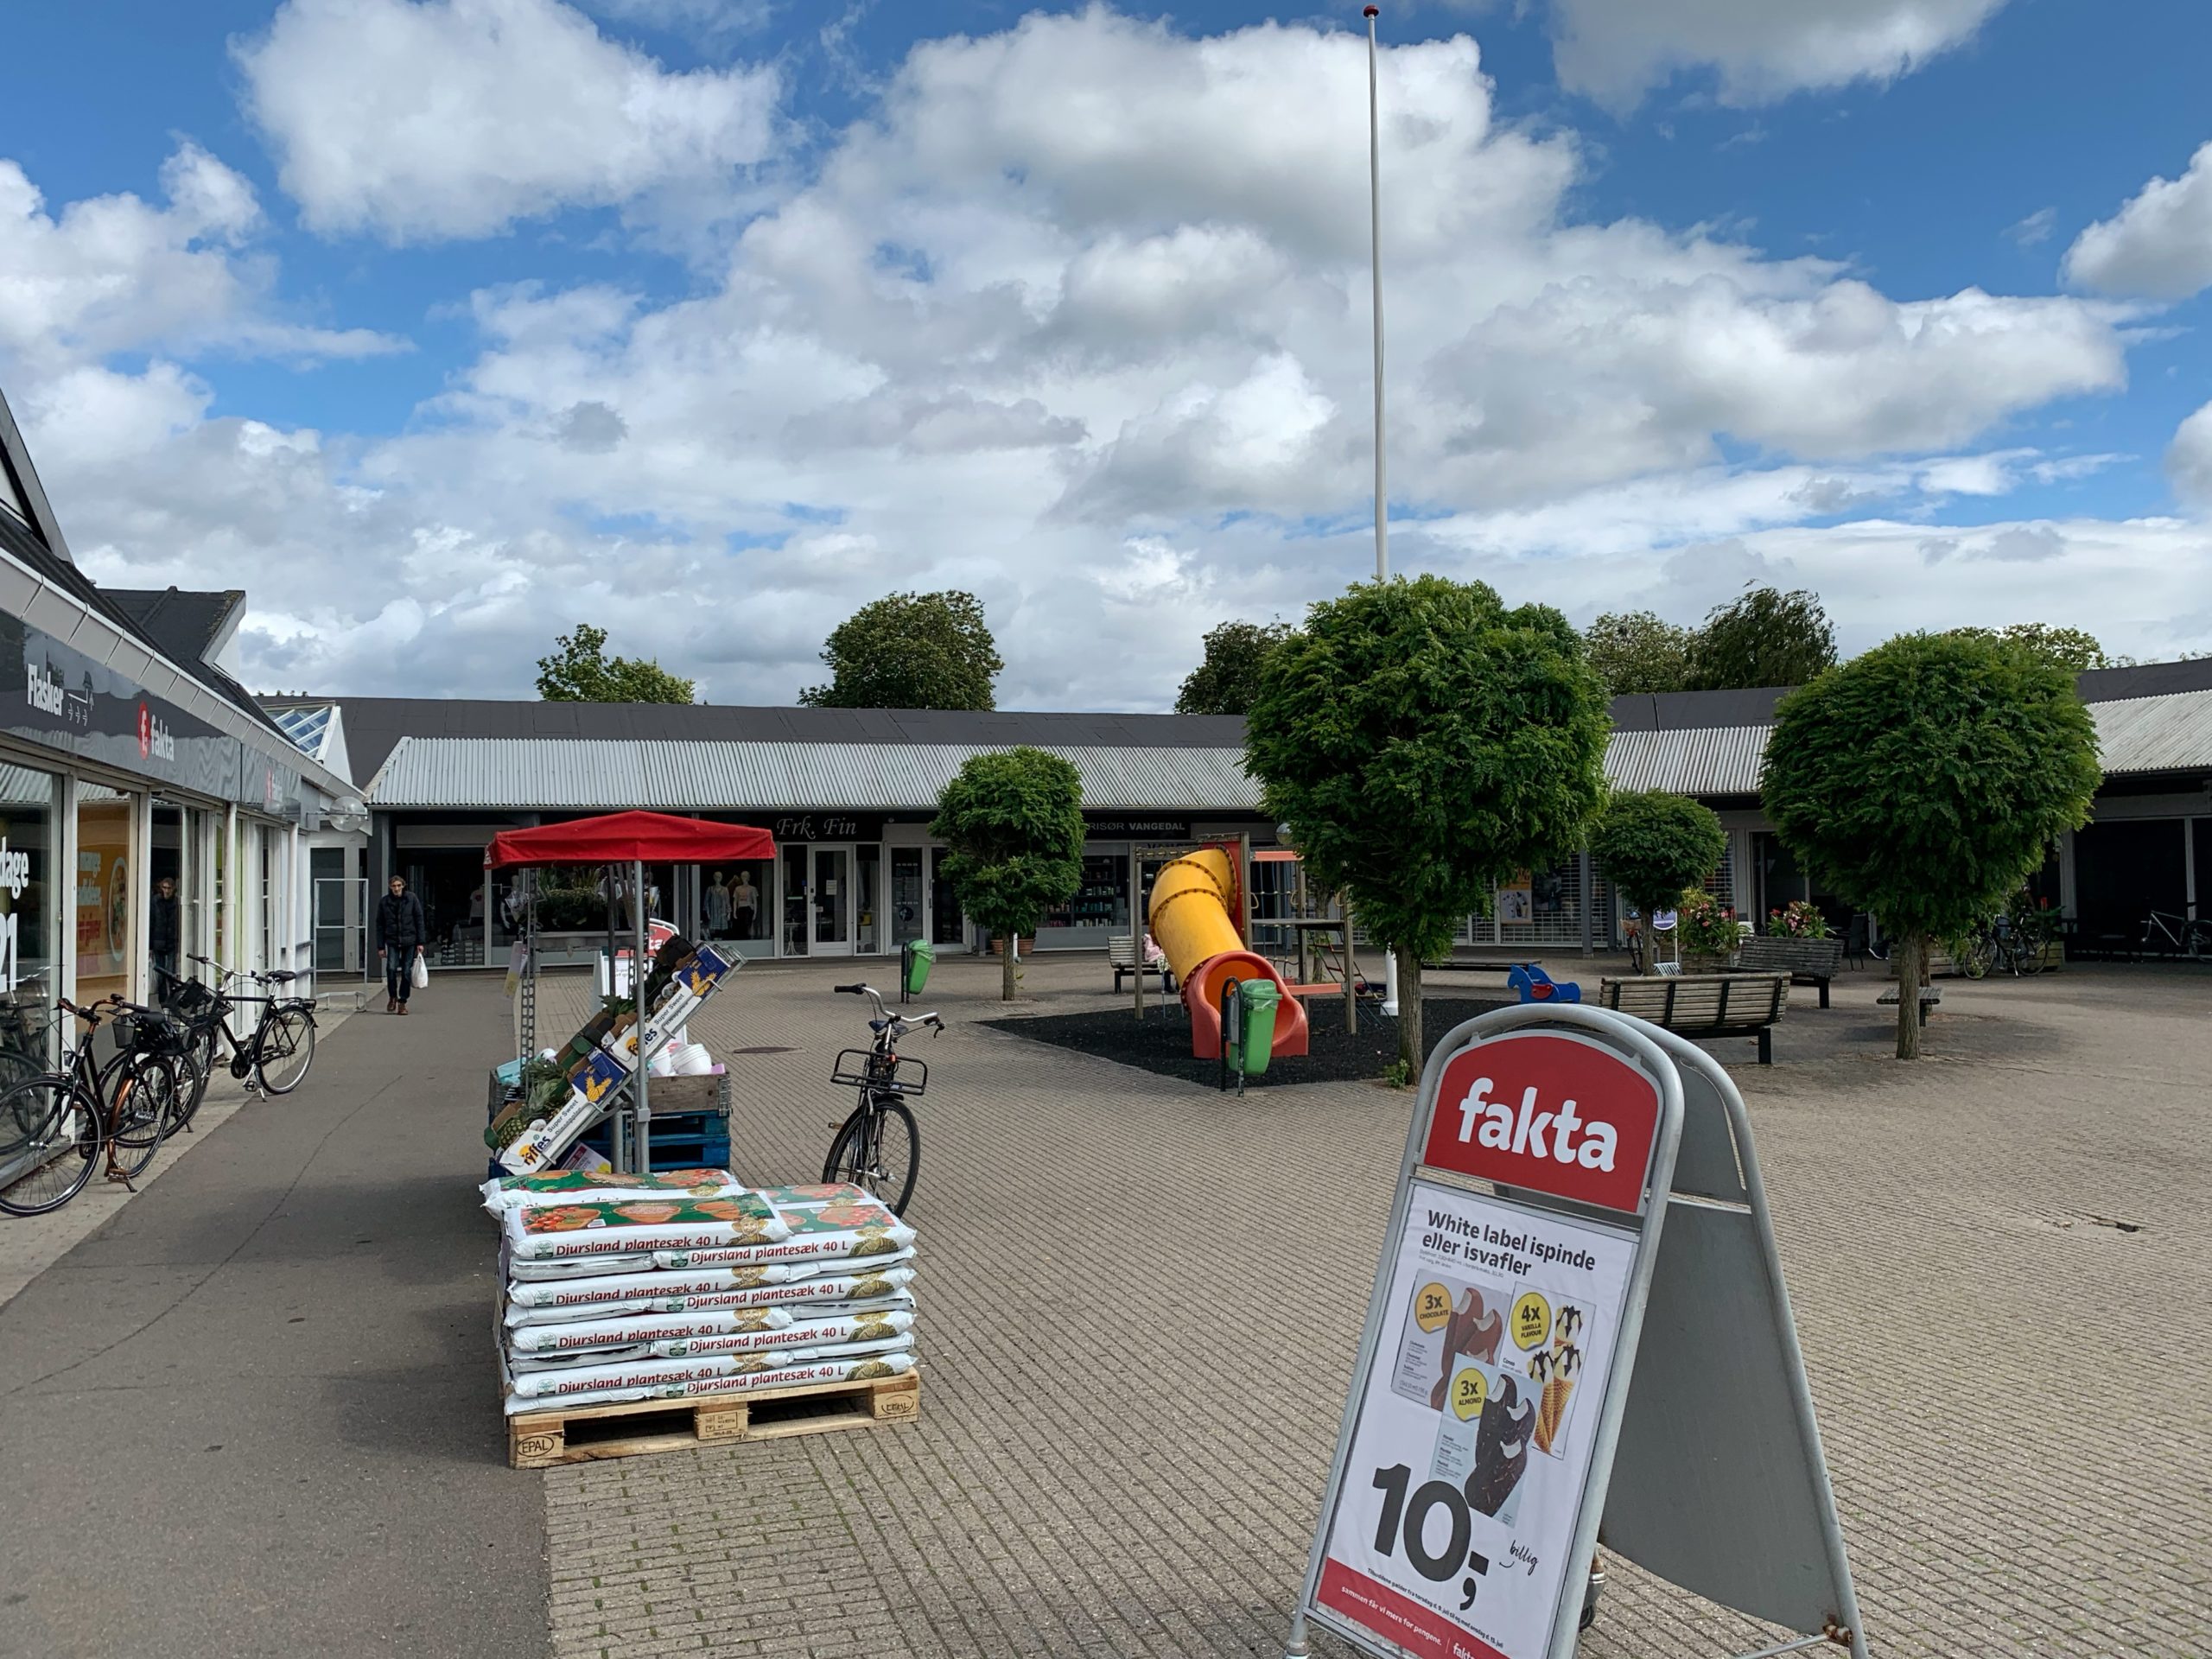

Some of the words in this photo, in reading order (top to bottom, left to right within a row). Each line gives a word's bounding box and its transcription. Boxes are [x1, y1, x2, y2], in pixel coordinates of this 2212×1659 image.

[27, 663, 64, 716] Flasker
[150, 714, 175, 761] fakta
[776, 815, 817, 840] Frk.
[823, 817, 857, 835] Fin
[1087, 822, 1125, 830] RISØR
[1128, 822, 1185, 830] VANGEDAL
[654, 1010, 670, 1025] Super
[668, 994, 684, 1010] Sweet
[547, 1116, 563, 1133] Super
[562, 1099, 579, 1116] Sweet
[1458, 1077, 1618, 1173] fakta
[556, 1240, 620, 1255] Djursland
[624, 1236, 690, 1252] plantesæk
[696, 1236, 710, 1246] 40
[715, 1236, 721, 1245] L
[691, 1248, 751, 1265] Djursland
[755, 1243, 819, 1261] plantesæk
[823, 1241, 837, 1251] 40
[842, 1241, 848, 1250] L
[1427, 1210, 1480, 1239] White
[1483, 1224, 1528, 1253] label
[1529, 1236, 1596, 1271] ispinde
[1422, 1232, 1460, 1255] eller
[1464, 1242, 1532, 1276] isvafler
[556, 1288, 620, 1304] Djursland
[625, 1283, 691, 1300] plantesæk
[696, 1282, 710, 1292] 40
[715, 1282, 721, 1291] L
[687, 1291, 747, 1309] Djursland
[752, 1286, 815, 1304] plantesæk
[819, 1284, 834, 1294] 40
[838, 1284, 844, 1294] L
[1425, 1294, 1443, 1311] 3x
[1420, 1309, 1449, 1320] CHOCOLATE
[1522, 1305, 1541, 1322] 4x
[559, 1332, 622, 1348] Djursland
[628, 1326, 694, 1342] plantesæk
[698, 1325, 713, 1335] 40
[717, 1325, 723, 1333] L
[690, 1335, 749, 1352] Djursland
[754, 1328, 817, 1348] plantesæk
[822, 1326, 836, 1338] 40
[841, 1326, 847, 1336] L
[1521, 1323, 1541, 1332] VANILLA
[1521, 1330, 1541, 1338] FLAVOUR
[559, 1376, 622, 1394] Djursland
[627, 1370, 693, 1388] plantesæk
[697, 1368, 712, 1377] 40
[716, 1367, 722, 1376] L
[687, 1375, 747, 1394] Djursland
[752, 1368, 815, 1388] plantesæk
[819, 1366, 834, 1377] 40
[838, 1366, 844, 1376] L
[1460, 1380, 1478, 1396] 3x
[1459, 1396, 1482, 1406] ALMOND
[522, 1439, 549, 1453] EPAL
[1510, 1540, 1539, 1576] billig
[1341, 1586, 1369, 1605] sammen
[1368, 1599, 1379, 1610] får
[1386, 1609, 1403, 1624] mere
[1402, 1618, 1414, 1629] for
[1413, 1624, 1442, 1646] pengene.
[1453, 1642, 1475, 1659] fakt
[1414, 1593, 1433, 1607] torsdag
[1460, 1618, 1471, 1628] med
[1470, 1624, 1486, 1639] onsdag
